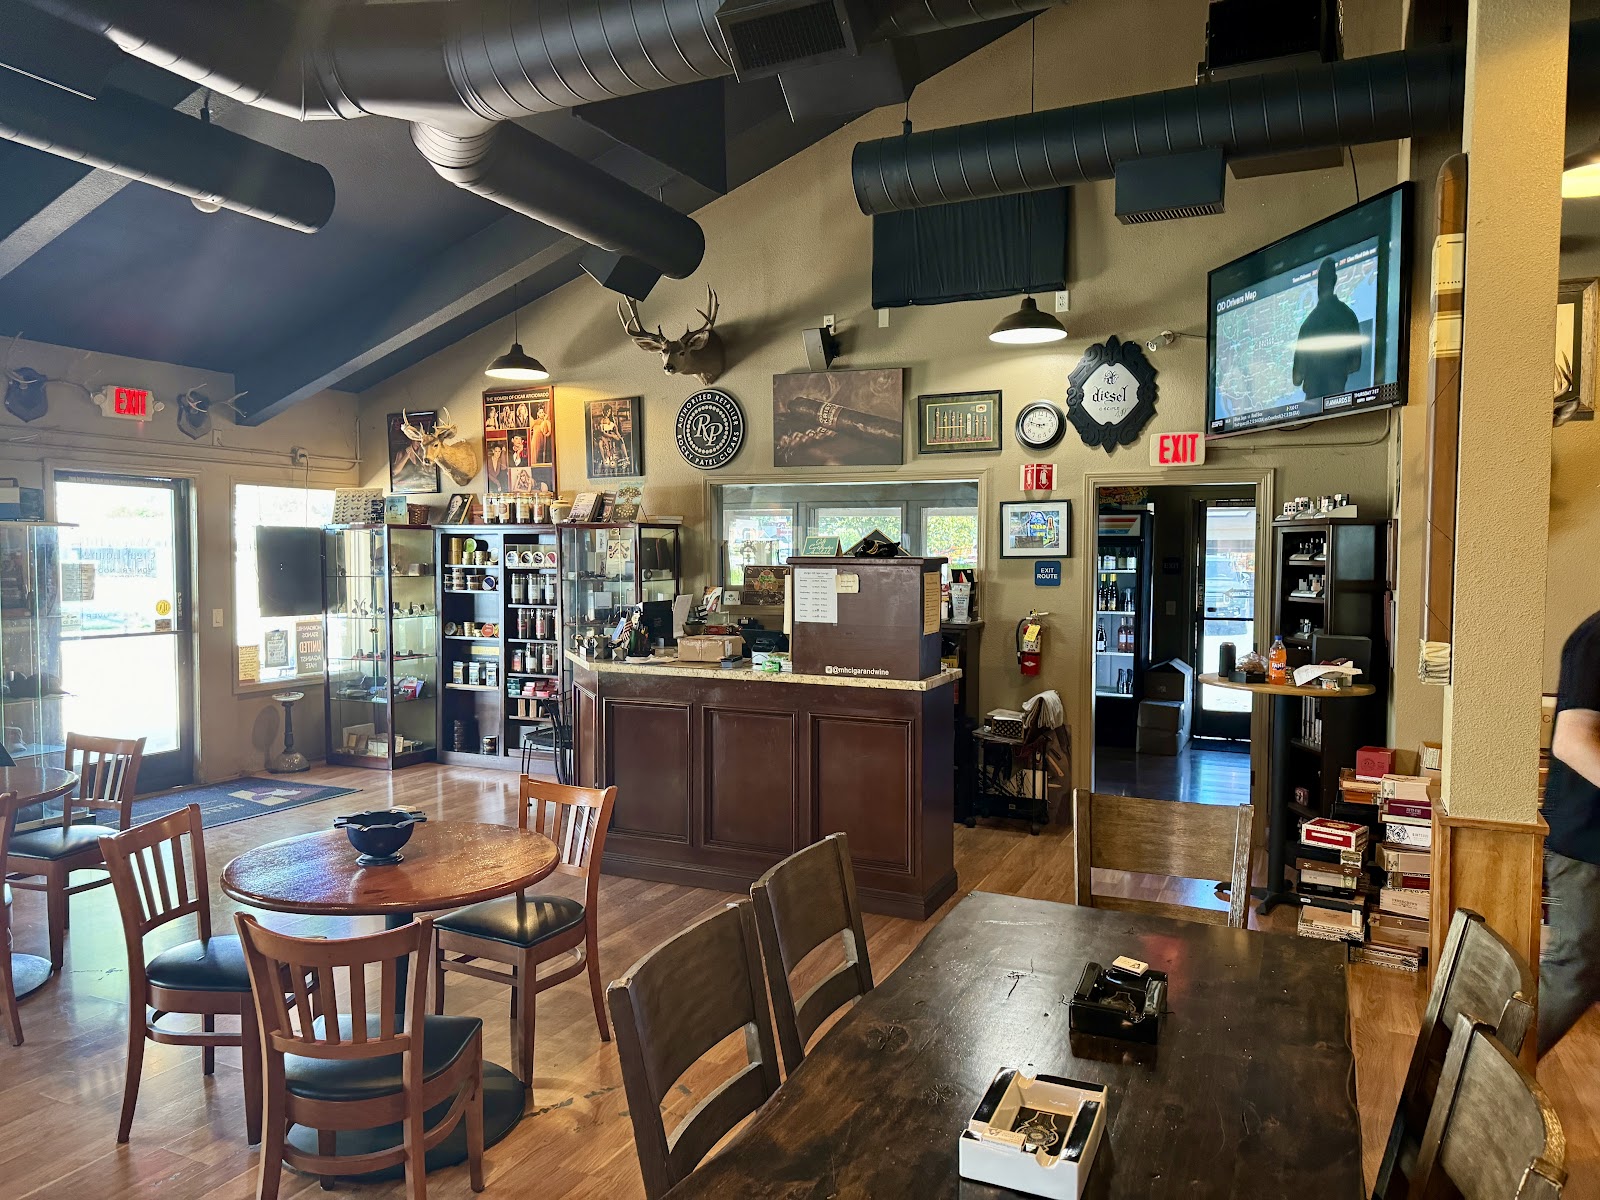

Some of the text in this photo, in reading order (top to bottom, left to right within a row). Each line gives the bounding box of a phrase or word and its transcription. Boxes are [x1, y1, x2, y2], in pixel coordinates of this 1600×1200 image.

[1226, 296, 1244, 309] Drivers
[1244, 290, 1257, 301] Map
[115, 387, 148, 416] EXIT
[1092, 384, 1128, 404] diesel
[677, 393, 739, 429] AUTHORIZED RETAILER
[677, 431, 739, 466] ROCKY PATEL CIGARS
[1159, 433, 1199, 464] EXIT
[832, 665, 889, 676] @mhcigarandwine
